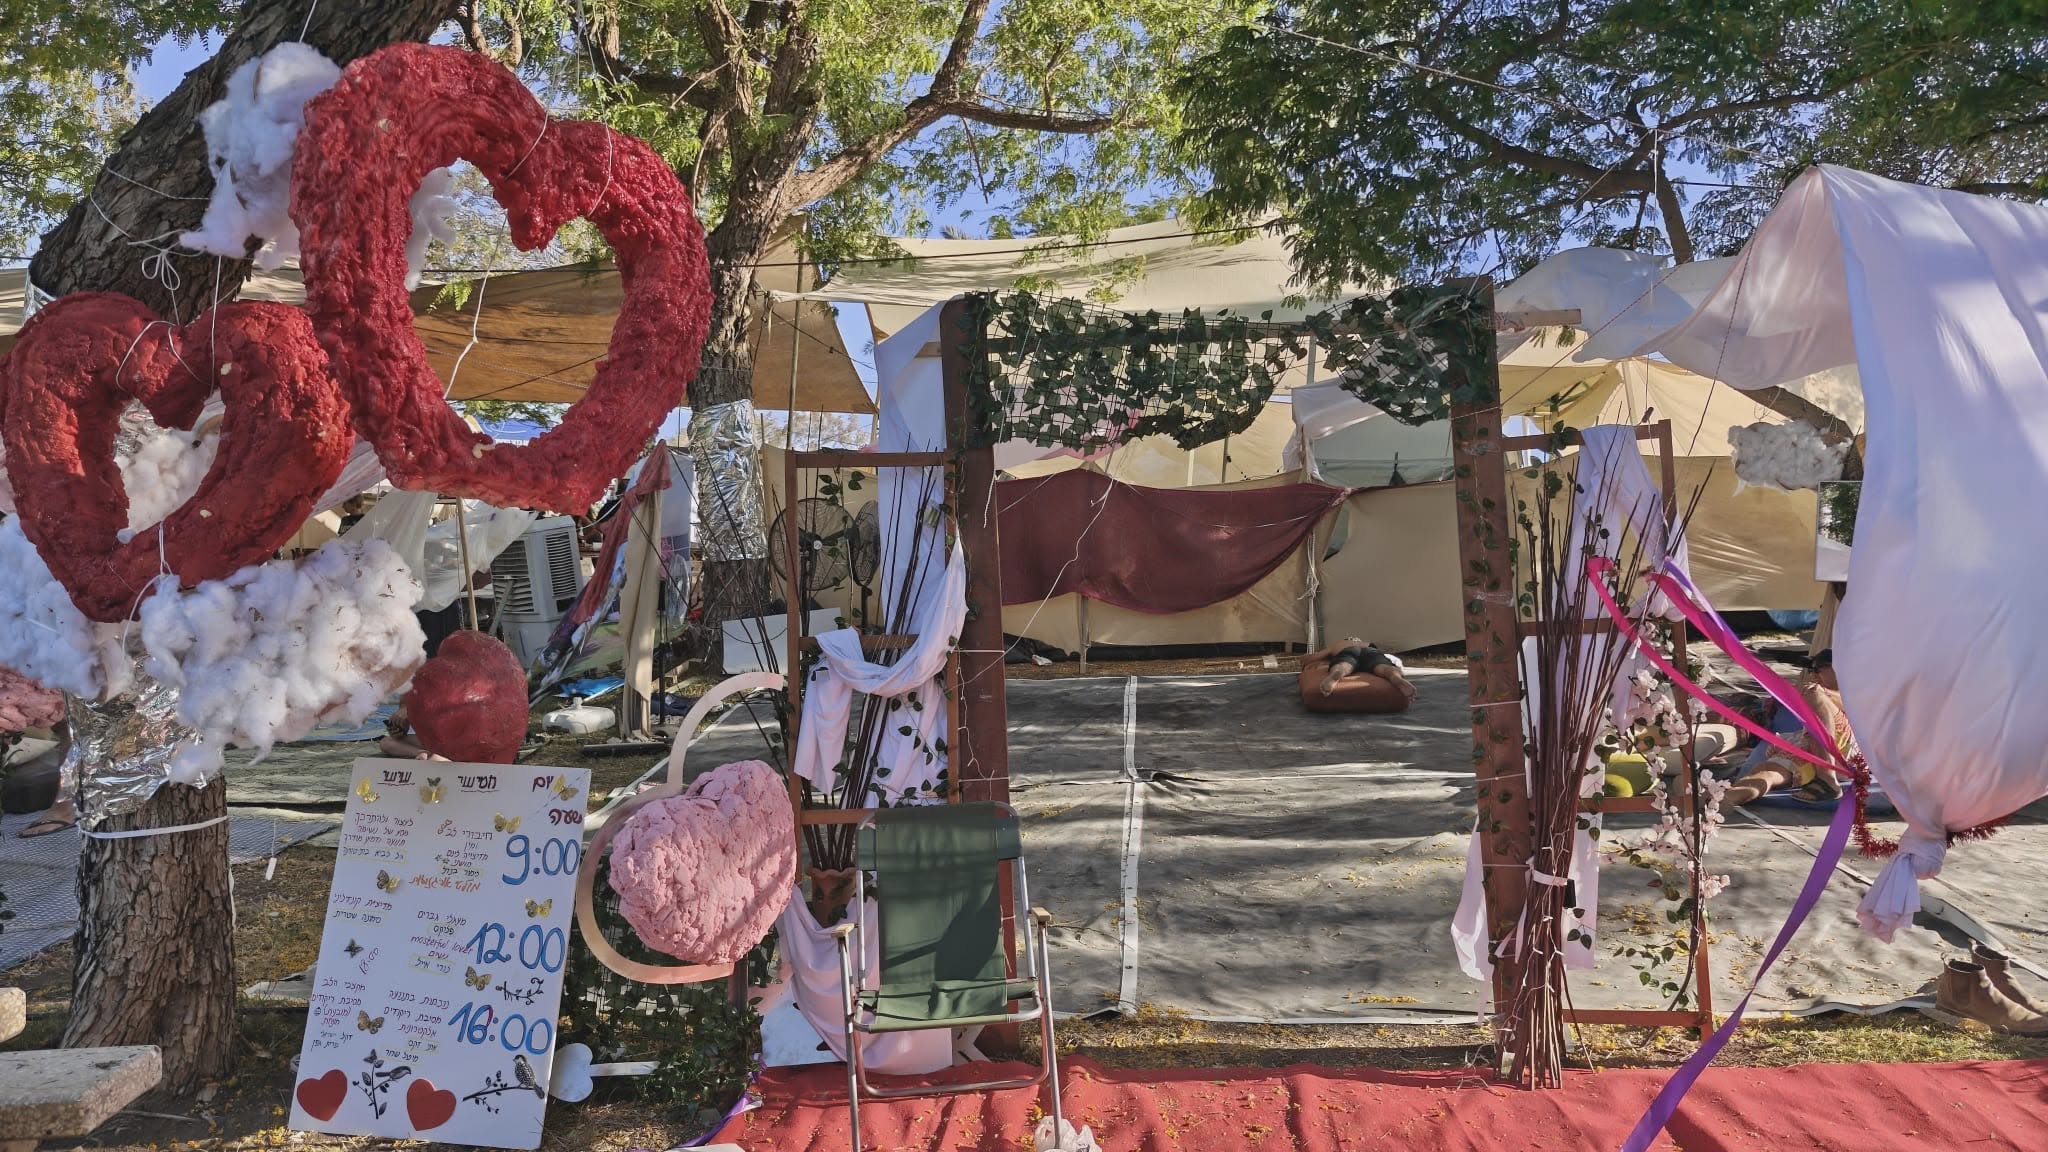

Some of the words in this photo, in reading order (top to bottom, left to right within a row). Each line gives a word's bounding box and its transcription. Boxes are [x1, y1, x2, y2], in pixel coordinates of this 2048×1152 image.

[382, 770, 413, 784] שישי
[457, 774, 497, 790] חמישי
[548, 808, 583, 826] שעה
[502, 834, 580, 886] 9:00
[466, 922, 566, 973] 12:00
